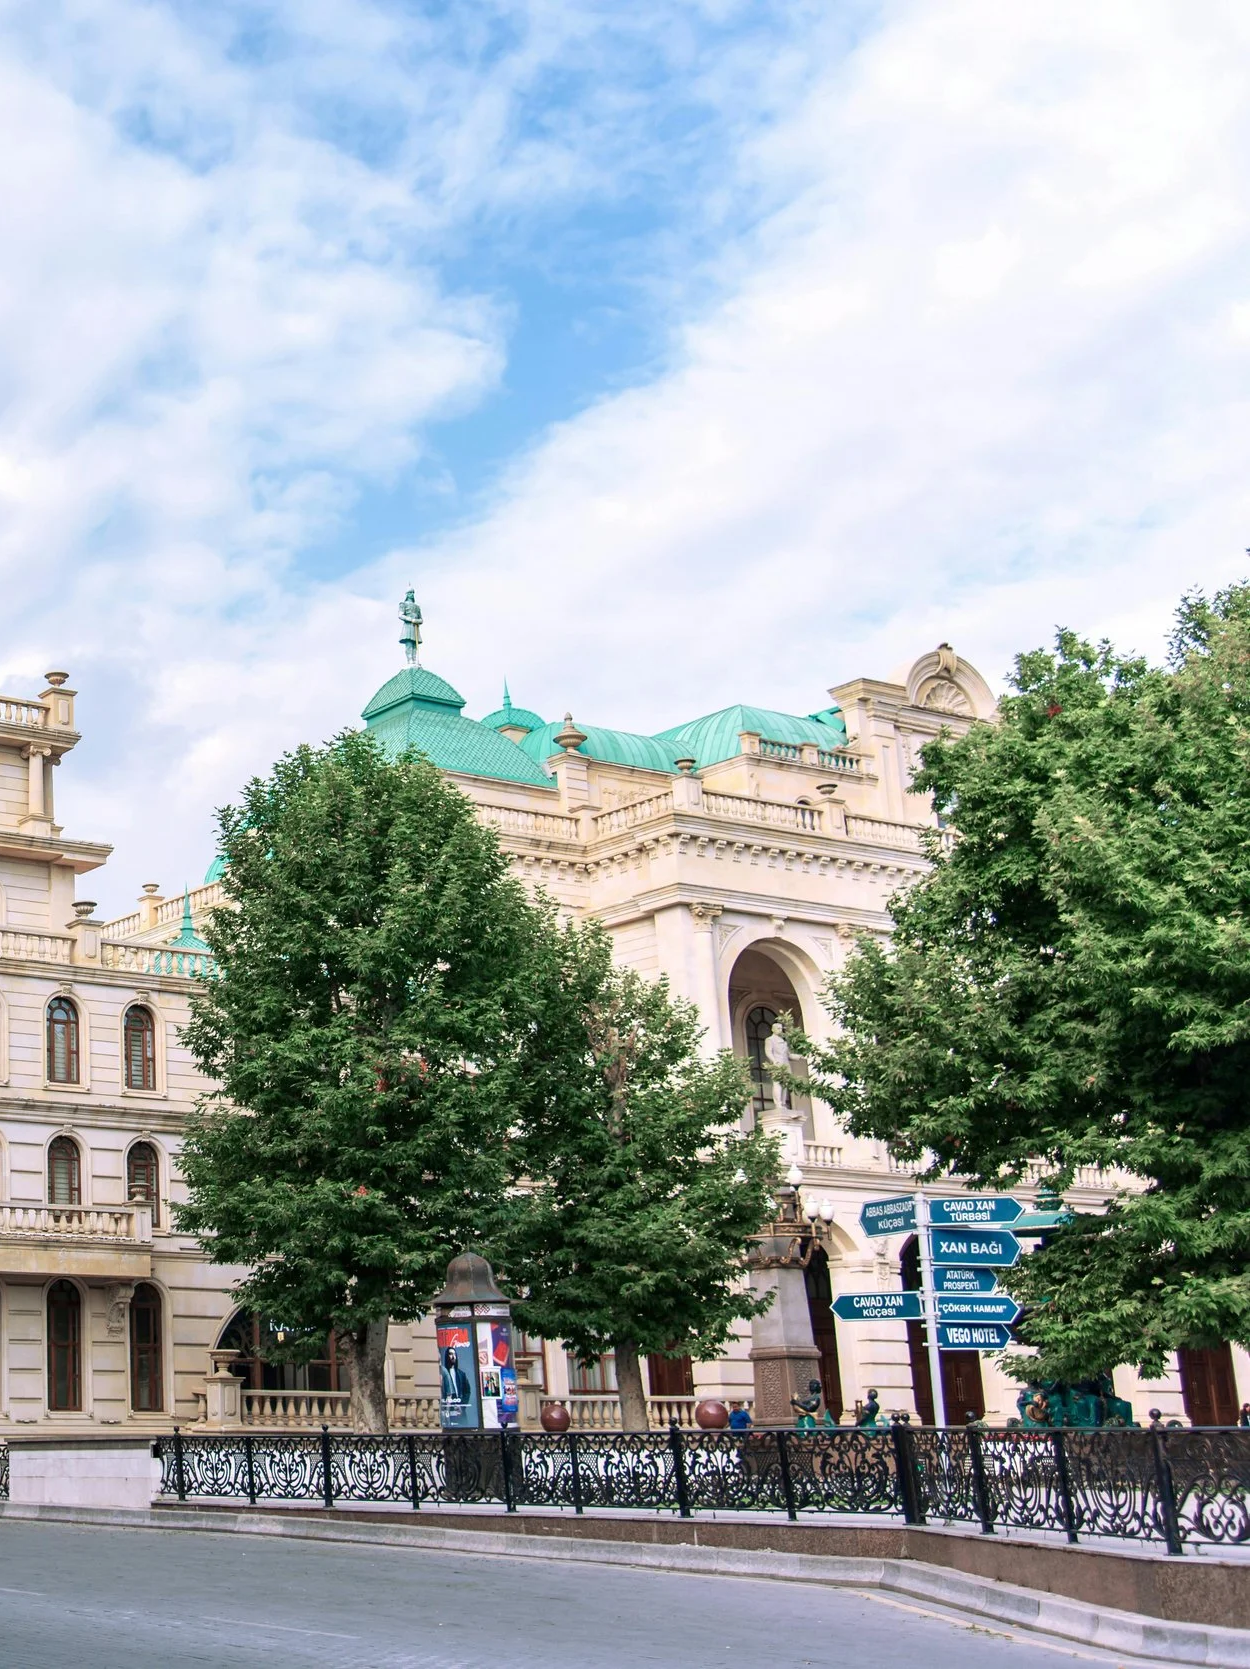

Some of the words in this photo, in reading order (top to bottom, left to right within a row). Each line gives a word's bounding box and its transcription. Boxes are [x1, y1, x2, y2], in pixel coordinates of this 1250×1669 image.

[943, 1201, 974, 1211] CAVAD
[976, 1200, 995, 1211] XAN
[865, 1205, 883, 1218] ABBAS
[949, 1211, 990, 1221] TÜRBƏSİ
[939, 1241, 967, 1253] XAN
[970, 1240, 1003, 1255] BAĞI
[946, 1269, 975, 1280] ATATÜRK
[943, 1280, 980, 1290] PROSPEKTİ
[853, 1296, 883, 1307] CAVAD
[884, 1295, 904, 1307] XAN
[946, 1327, 971, 1343] VEGO
[971, 1327, 1001, 1344] HOTEL
